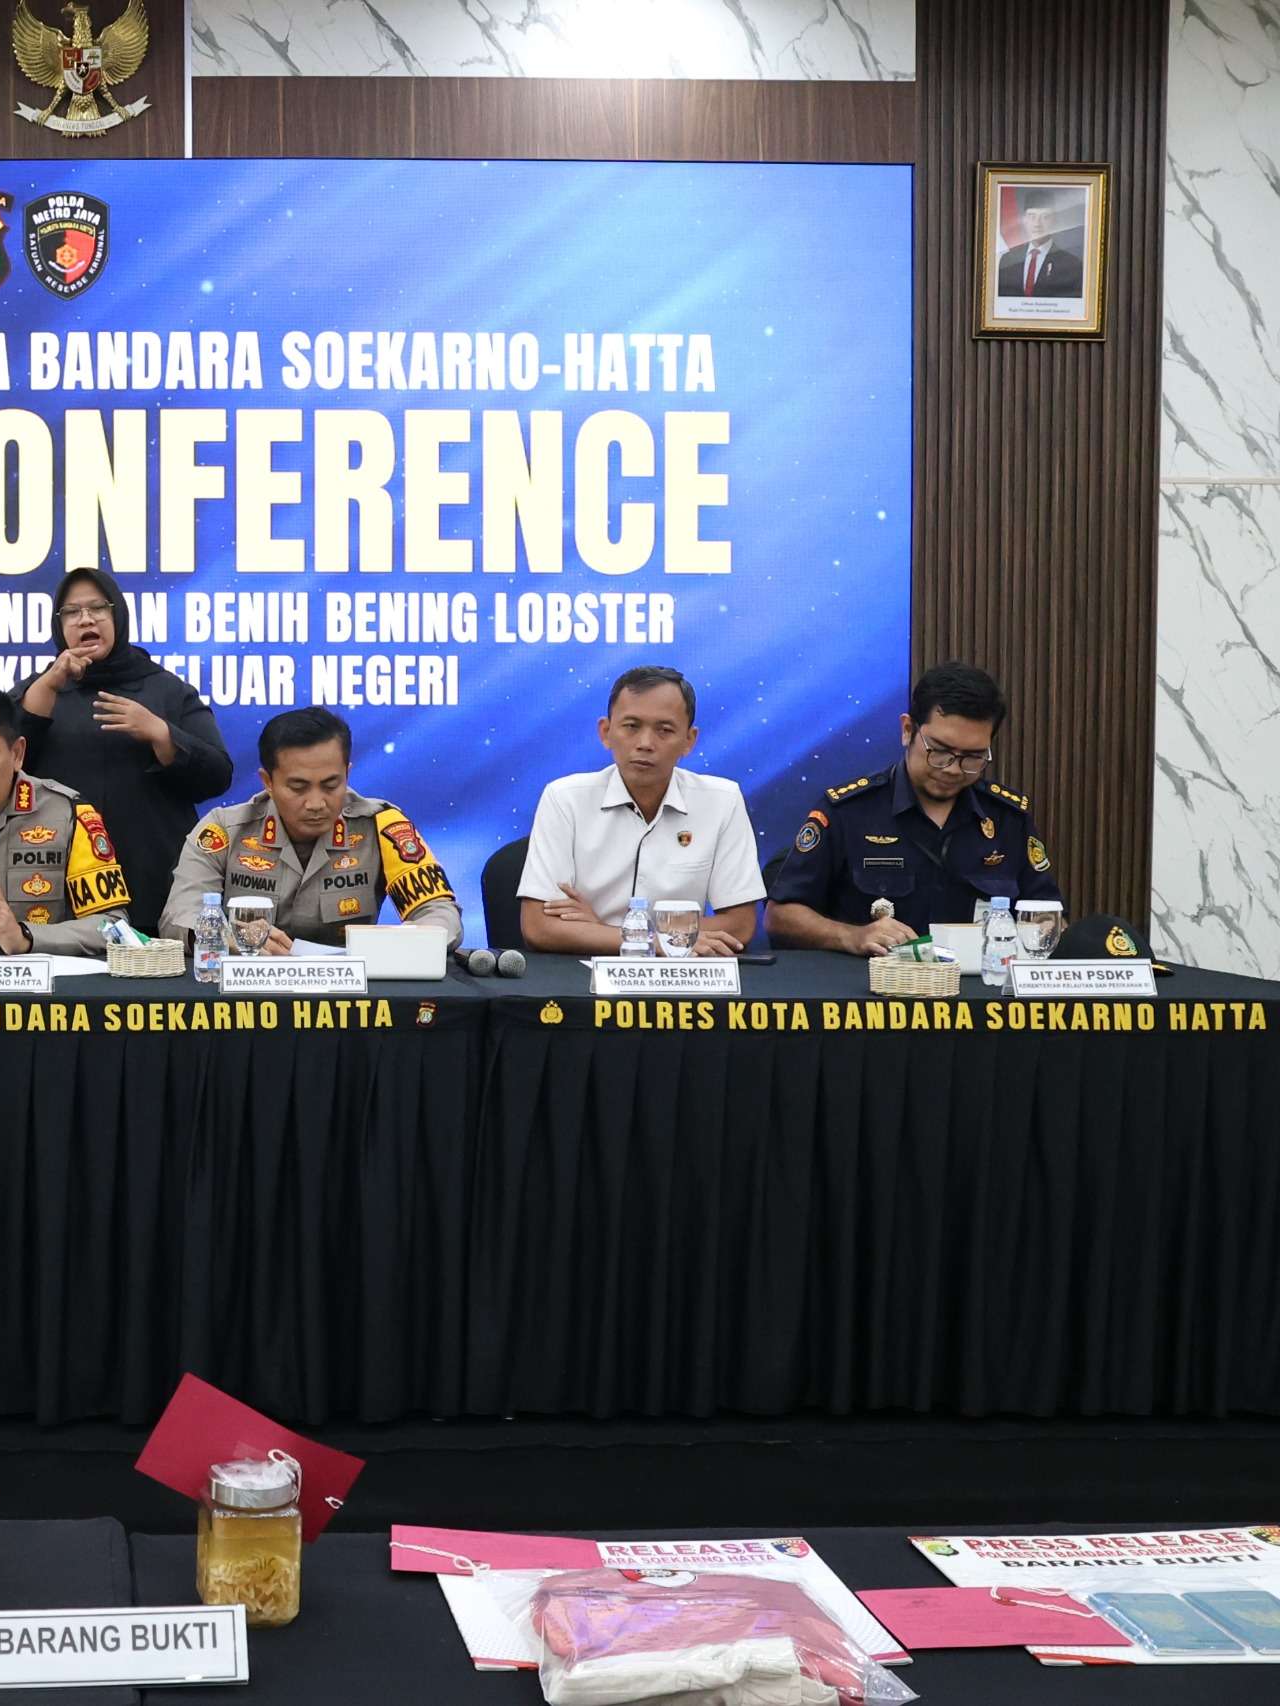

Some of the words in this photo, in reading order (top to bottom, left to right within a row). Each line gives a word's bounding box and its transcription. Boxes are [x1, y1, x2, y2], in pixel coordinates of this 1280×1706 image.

[48, 195, 85, 208] POLDA
[32, 207, 71, 225] METRO
[73, 208, 101, 226] JAYA
[29, 232, 43, 272] SATUAN
[30, 331, 263, 391] BANDARA
[281, 331, 716, 393] SOEKARNO-HATTA
[185, 592, 309, 644] BENIH
[334, 592, 477, 645] BENING
[494, 592, 675, 645] LOBSTER
[320, 654, 460, 707] NEGERI
[12, 850, 62, 866] POLRI
[230, 872, 277, 893] WIDWAN
[323, 871, 369, 890] POLRI
[69, 876, 96, 910] KA
[96, 869, 127, 901] OPS
[232, 967, 354, 978] WAKAPOLRESTA
[607, 967, 655, 978] KASAT
[660, 967, 726, 978] RESKRIM
[1030, 970, 1082, 981] DITJEN
[1087, 970, 1135, 981] PSDKP
[14, 978, 43, 986] HATTA
[275, 978, 328, 986] SOEKARNO
[330, 978, 362, 986] HATTA
[609, 979, 646, 987] NDARA
[648, 979, 701, 987] SOEKARNO
[703, 979, 734, 987] HATTA
[104, 1002, 278, 1032] SOEKARNO
[293, 1000, 393, 1029] HATTA
[594, 1000, 715, 1030] POLRES
[728, 1002, 810, 1030] KOTA
[822, 1001, 974, 1030] BANDARA
[986, 1002, 1155, 1031] SOEKARNO
[1169, 1002, 1267, 1031] HATTA
[605, 1541, 766, 1557] RELEASE
[962, 1537, 1082, 1551] PRESS
[1086, 1531, 1250, 1549] RELEASE
[643, 1555, 724, 1564] SOEKARNO
[728, 1554, 777, 1563] HATTA
[976, 1550, 1052, 1559] POLRESTA
[1056, 1549, 1127, 1559] BANDARA
[1131, 1546, 1214, 1557] SOEKARNO
[1215, 1544, 1266, 1553] HATTA
[1001, 1558, 1144, 1568] BARANG
[1153, 1554, 1262, 1566] BUKTI
[131, 1622, 218, 1651] BUKTI
